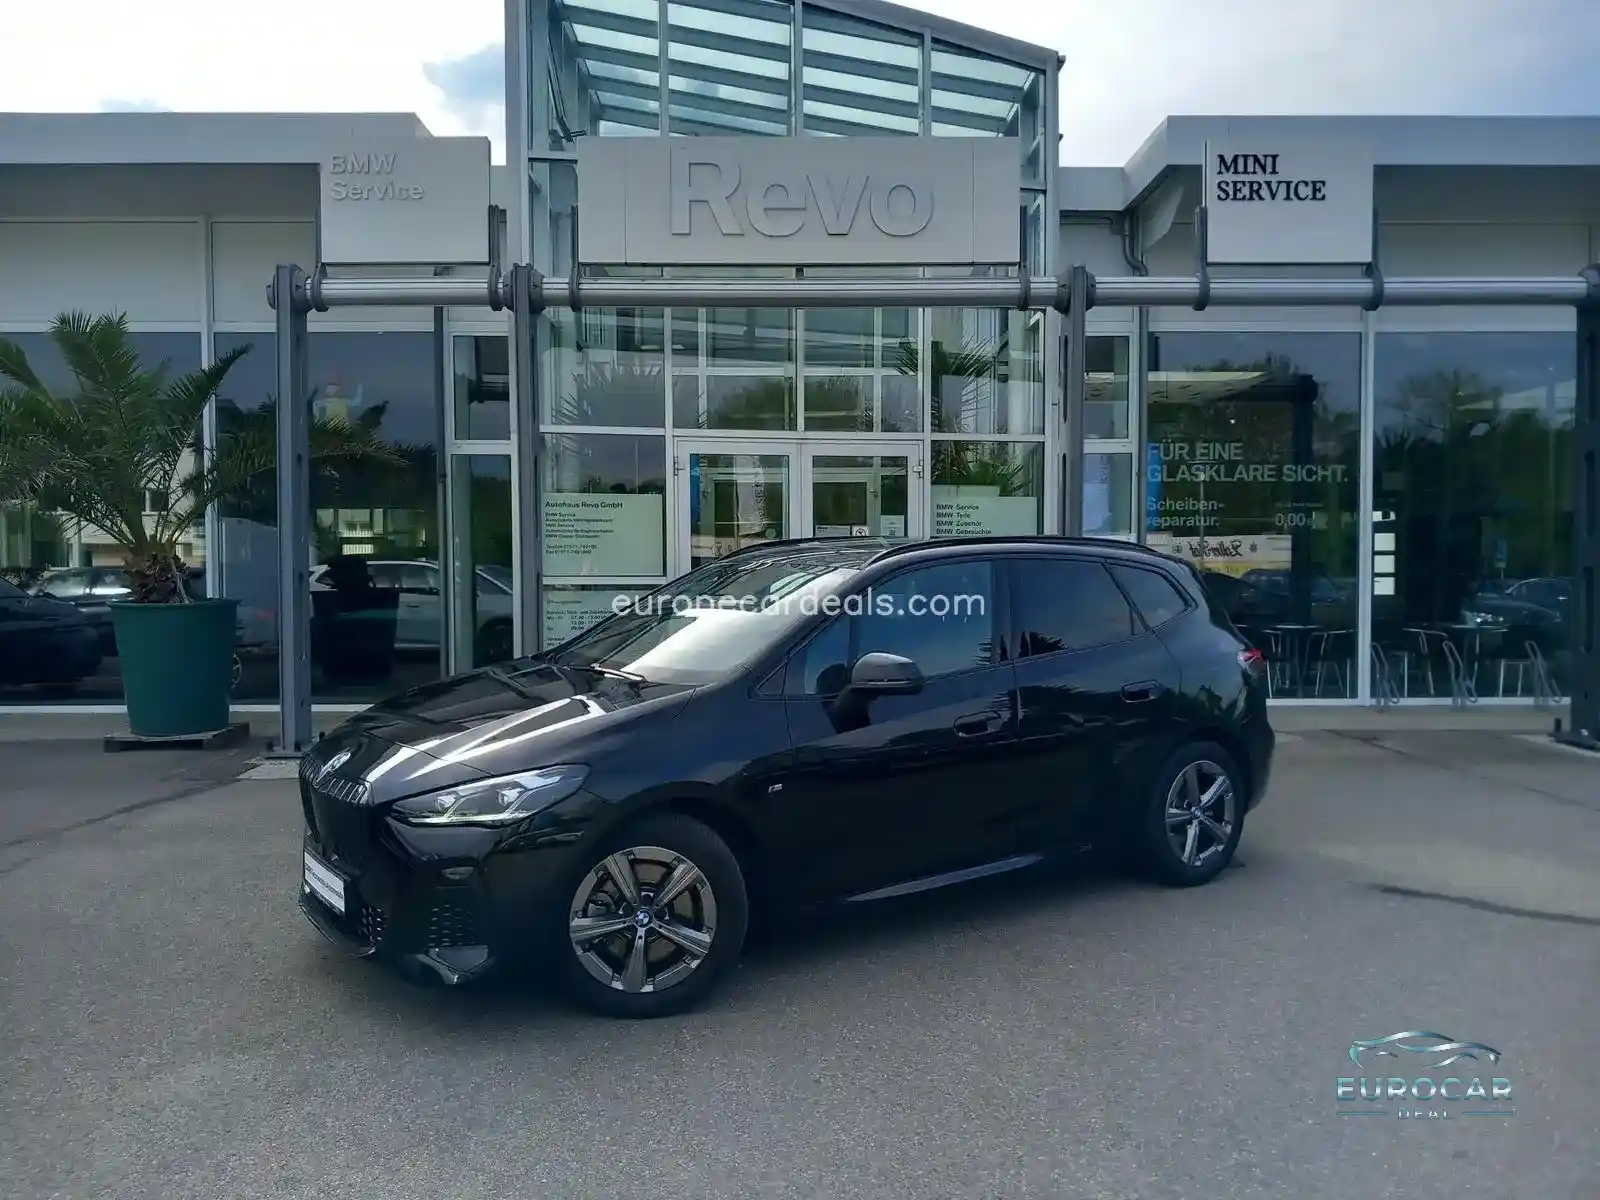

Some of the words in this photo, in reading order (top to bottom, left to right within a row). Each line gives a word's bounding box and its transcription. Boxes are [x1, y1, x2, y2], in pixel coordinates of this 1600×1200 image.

[330, 152, 399, 174] BMW
[1217, 154, 1279, 175] MINI
[330, 180, 425, 201] Service
[669, 147, 934, 238] Revo
[1217, 180, 1326, 201] SERVICE
[1147, 438, 1189, 460] FÜR
[1195, 443, 1244, 460] EINE
[1147, 464, 1278, 482] GLASKLARE
[1282, 464, 1349, 482] SICHT.
[544, 501, 580, 509] Autohaus
[581, 501, 599, 509] Revo
[600, 501, 623, 509] GmbH
